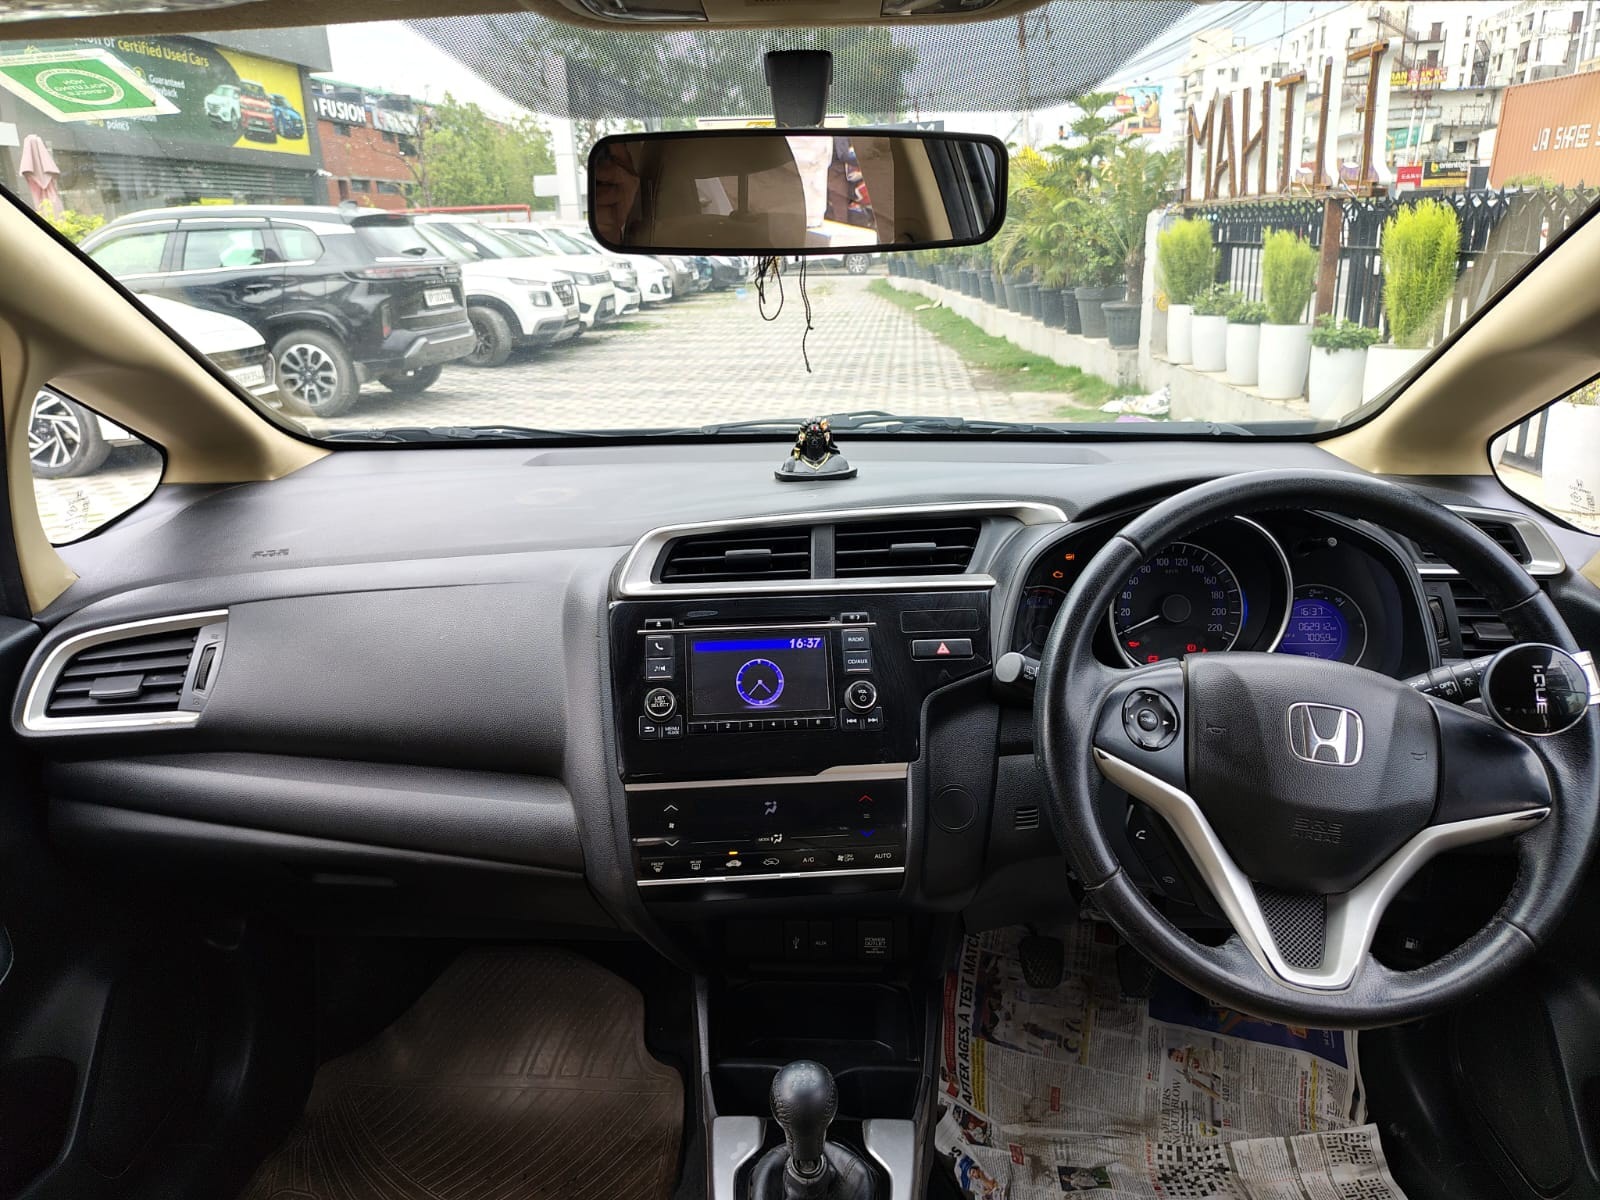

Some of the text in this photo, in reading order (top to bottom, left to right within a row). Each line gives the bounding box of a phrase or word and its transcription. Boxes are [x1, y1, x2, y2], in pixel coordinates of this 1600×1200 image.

[162, 47, 188, 63] Used
[189, 52, 209, 67] Cars
[318, 97, 367, 123] FUSION
[1156, 558, 1169, 567] 100
[1175, 558, 1189, 567] 120
[1140, 565, 1151, 574] 80
[1191, 565, 1205, 574] 140
[1128, 577, 1139, 585] 60
[1203, 576, 1217, 585] 160
[1122, 591, 1132, 600] 40
[1211, 591, 1224, 600] 180
[1120, 608, 1131, 616] 20
[1211, 608, 1227, 616] 200
[1207, 624, 1223, 632] 220
[789, 637, 821, 649] 16:37
[959, 976, 973, 1010] TEST
[958, 1013, 969, 1023] A
[959, 1063, 972, 1106] AFTER
